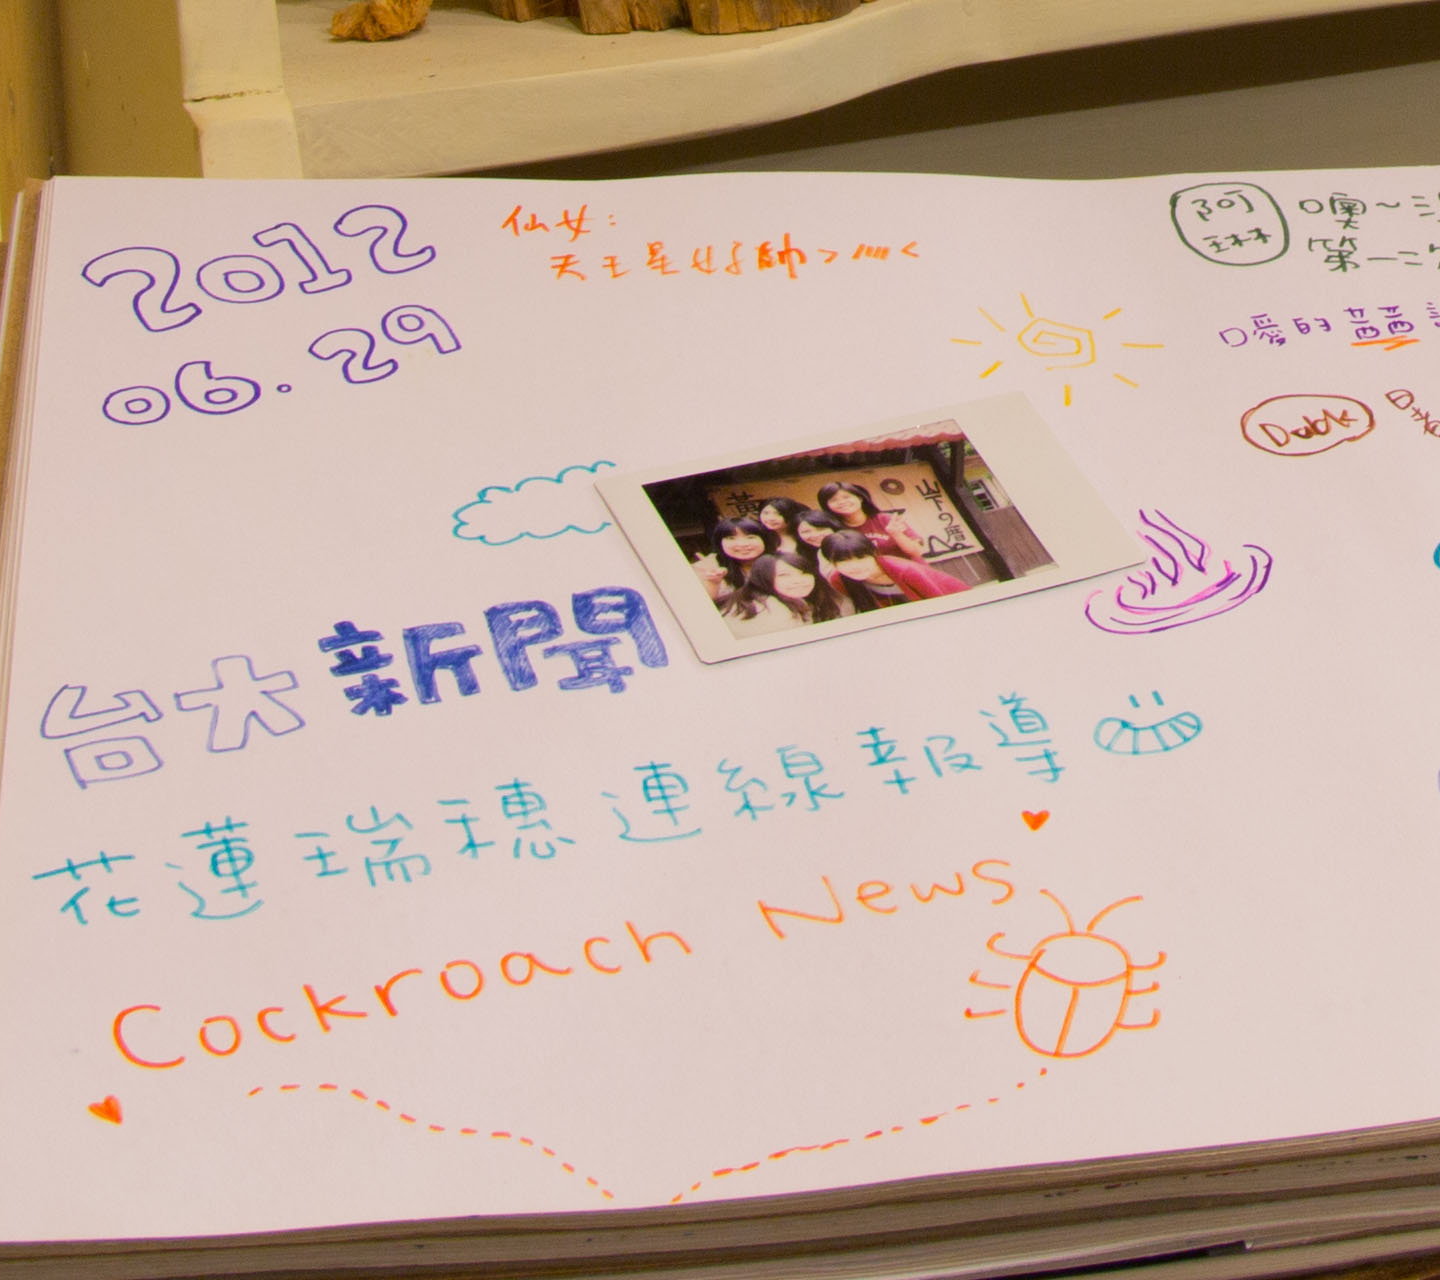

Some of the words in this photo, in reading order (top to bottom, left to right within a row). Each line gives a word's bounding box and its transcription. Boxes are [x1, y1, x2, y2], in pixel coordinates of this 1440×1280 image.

[81, 203, 437, 333] 2012
[102, 303, 463, 426] 06.29
[110, 919, 693, 1071] Cockroach
[756, 856, 1017, 940] News
